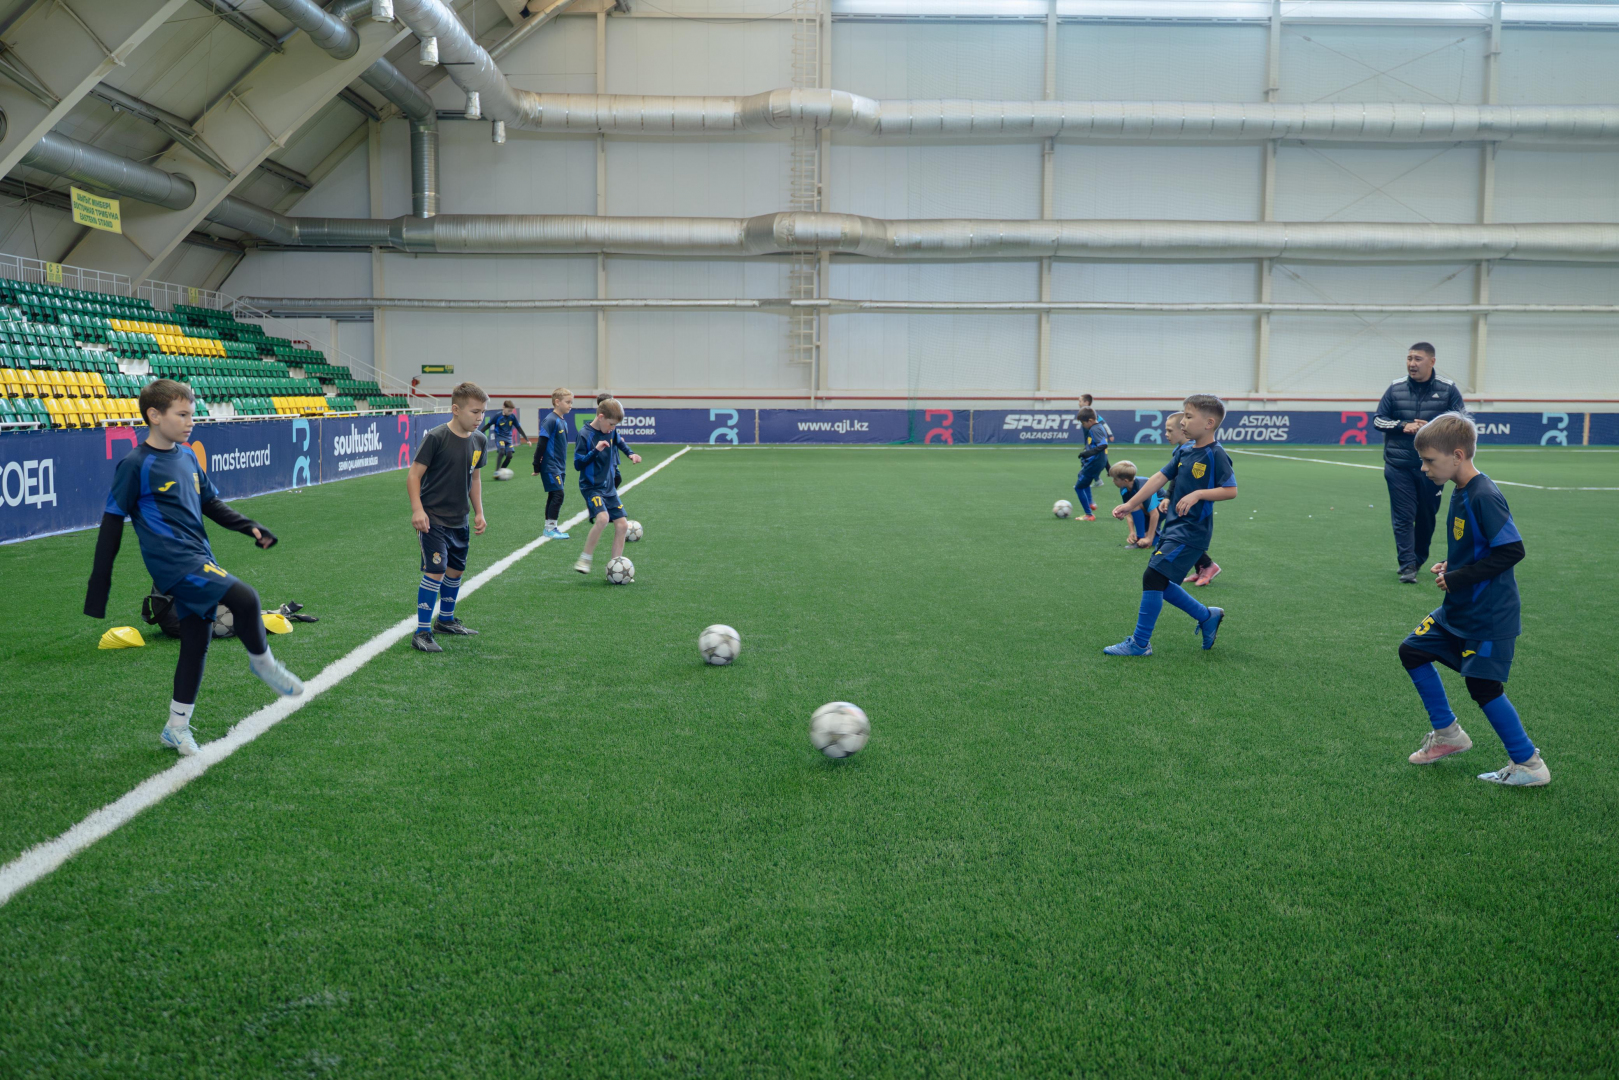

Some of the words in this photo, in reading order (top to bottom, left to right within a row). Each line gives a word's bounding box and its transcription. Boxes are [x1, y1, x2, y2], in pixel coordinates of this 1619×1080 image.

[616, 416, 656, 427] EDOM
[797, 419, 869, 434] www.qjl.kz
[1239, 415, 1290, 426] ASTANA
[1019, 432, 1069, 440] QAZAQSTAN
[1217, 427, 1289, 441] MOTORS
[1475, 423, 1510, 435] GAN
[334, 422, 382, 456] soultustik.
[211, 443, 271, 473] mastercard
[0, 458, 57, 509] ОЕД
[591, 496, 603, 508] 17
[203, 560, 228, 578] 1
[1413, 614, 1436, 636] 5
